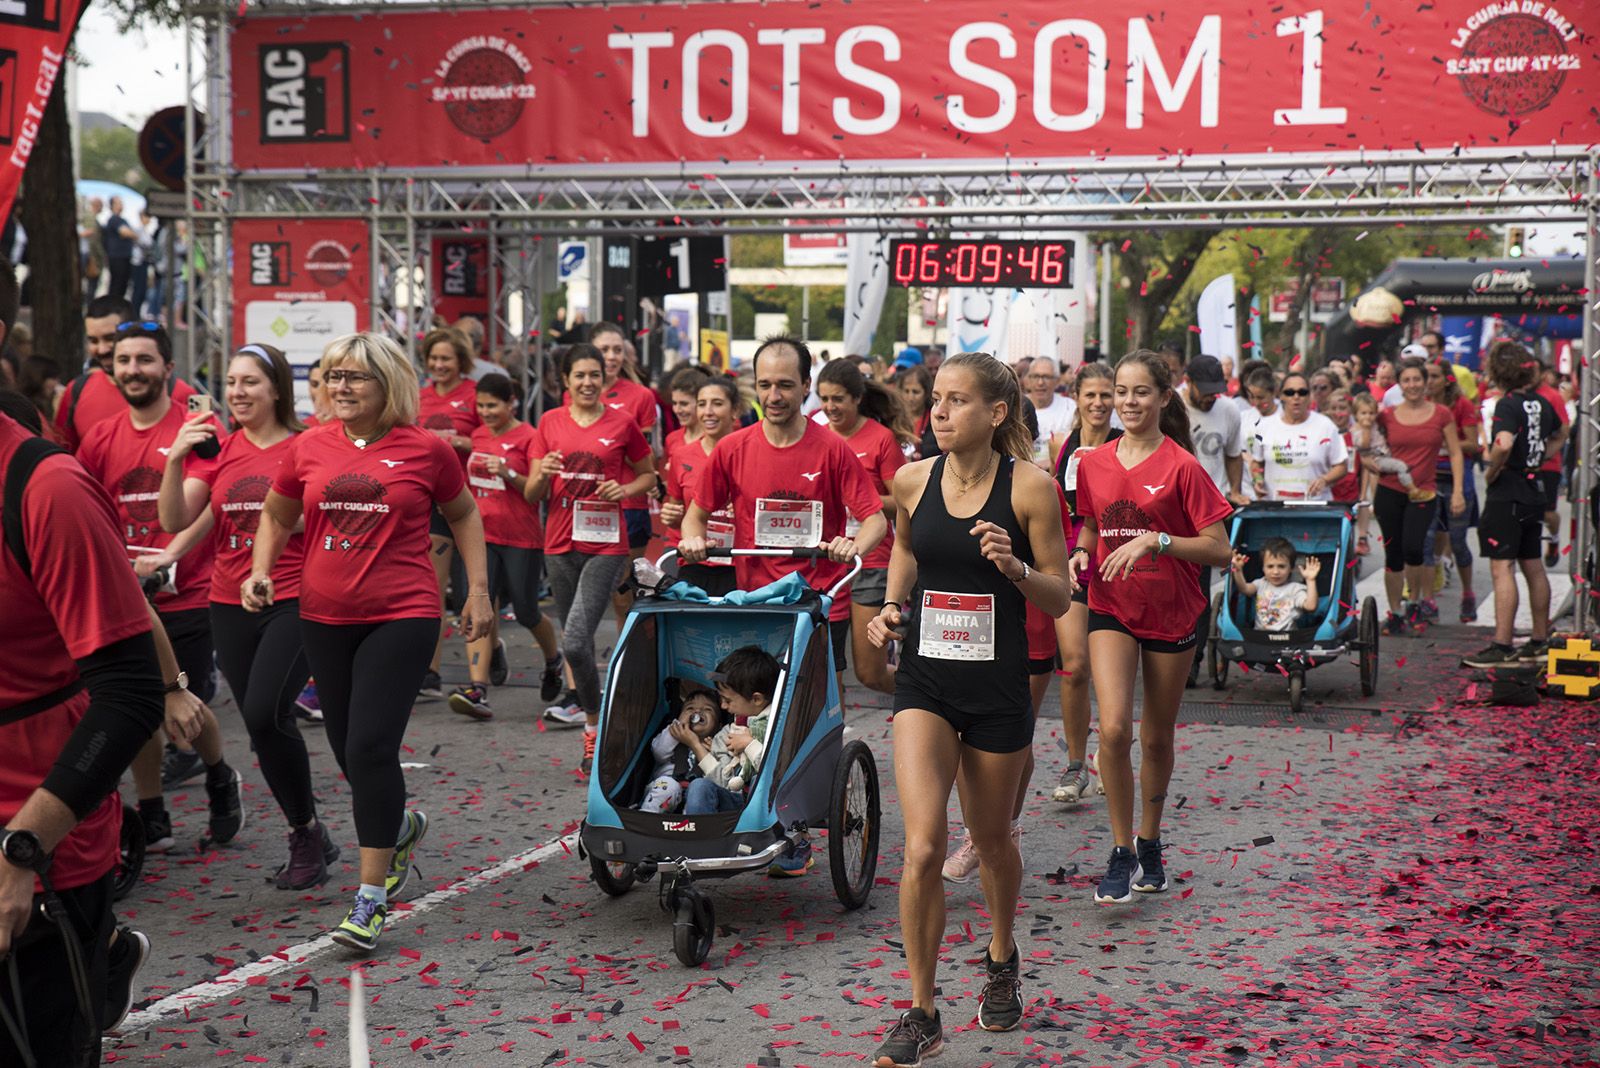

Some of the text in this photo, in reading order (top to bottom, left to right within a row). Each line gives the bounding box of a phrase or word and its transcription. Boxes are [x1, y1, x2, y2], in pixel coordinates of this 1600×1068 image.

[1451, 27, 1472, 49] LA
[1521, 0, 1546, 16] DE
[434, 60, 452, 79] LA
[607, 10, 1347, 137] TOTS SOM 1
[10, 46, 62, 168] rac1.cat
[264, 48, 305, 137] RAC
[252, 243, 272, 285] RAC
[895, 244, 1064, 283] 06:09:46
[318, 501, 342, 511] SANT
[585, 516, 611, 527] 3453
[770, 517, 802, 528] 3170
[935, 613, 979, 628] MARTA
[942, 630, 970, 641] 2372
